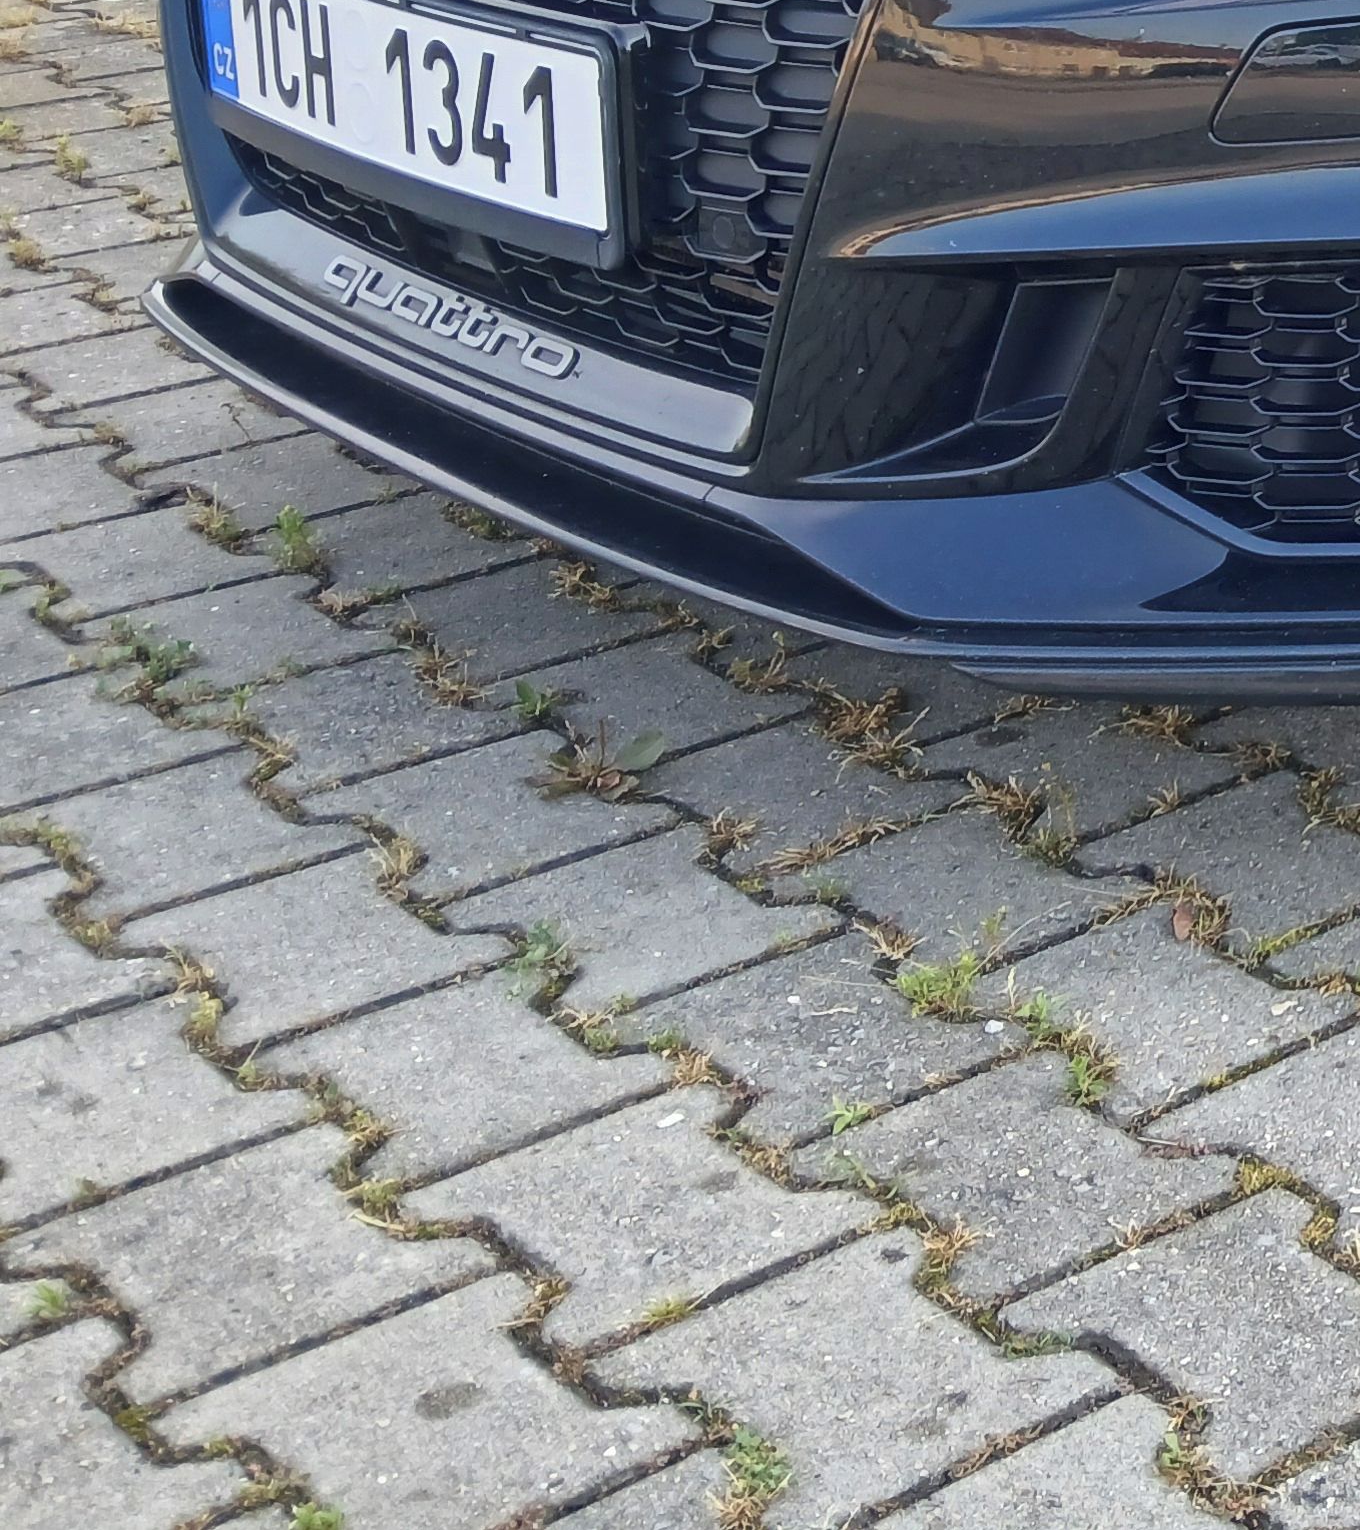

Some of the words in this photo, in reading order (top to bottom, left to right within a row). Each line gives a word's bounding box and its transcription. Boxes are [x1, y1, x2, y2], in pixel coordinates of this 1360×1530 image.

[212, 41, 236, 81] CZ
[385, 27, 559, 200] 1341
[324, 255, 576, 378] quattro
